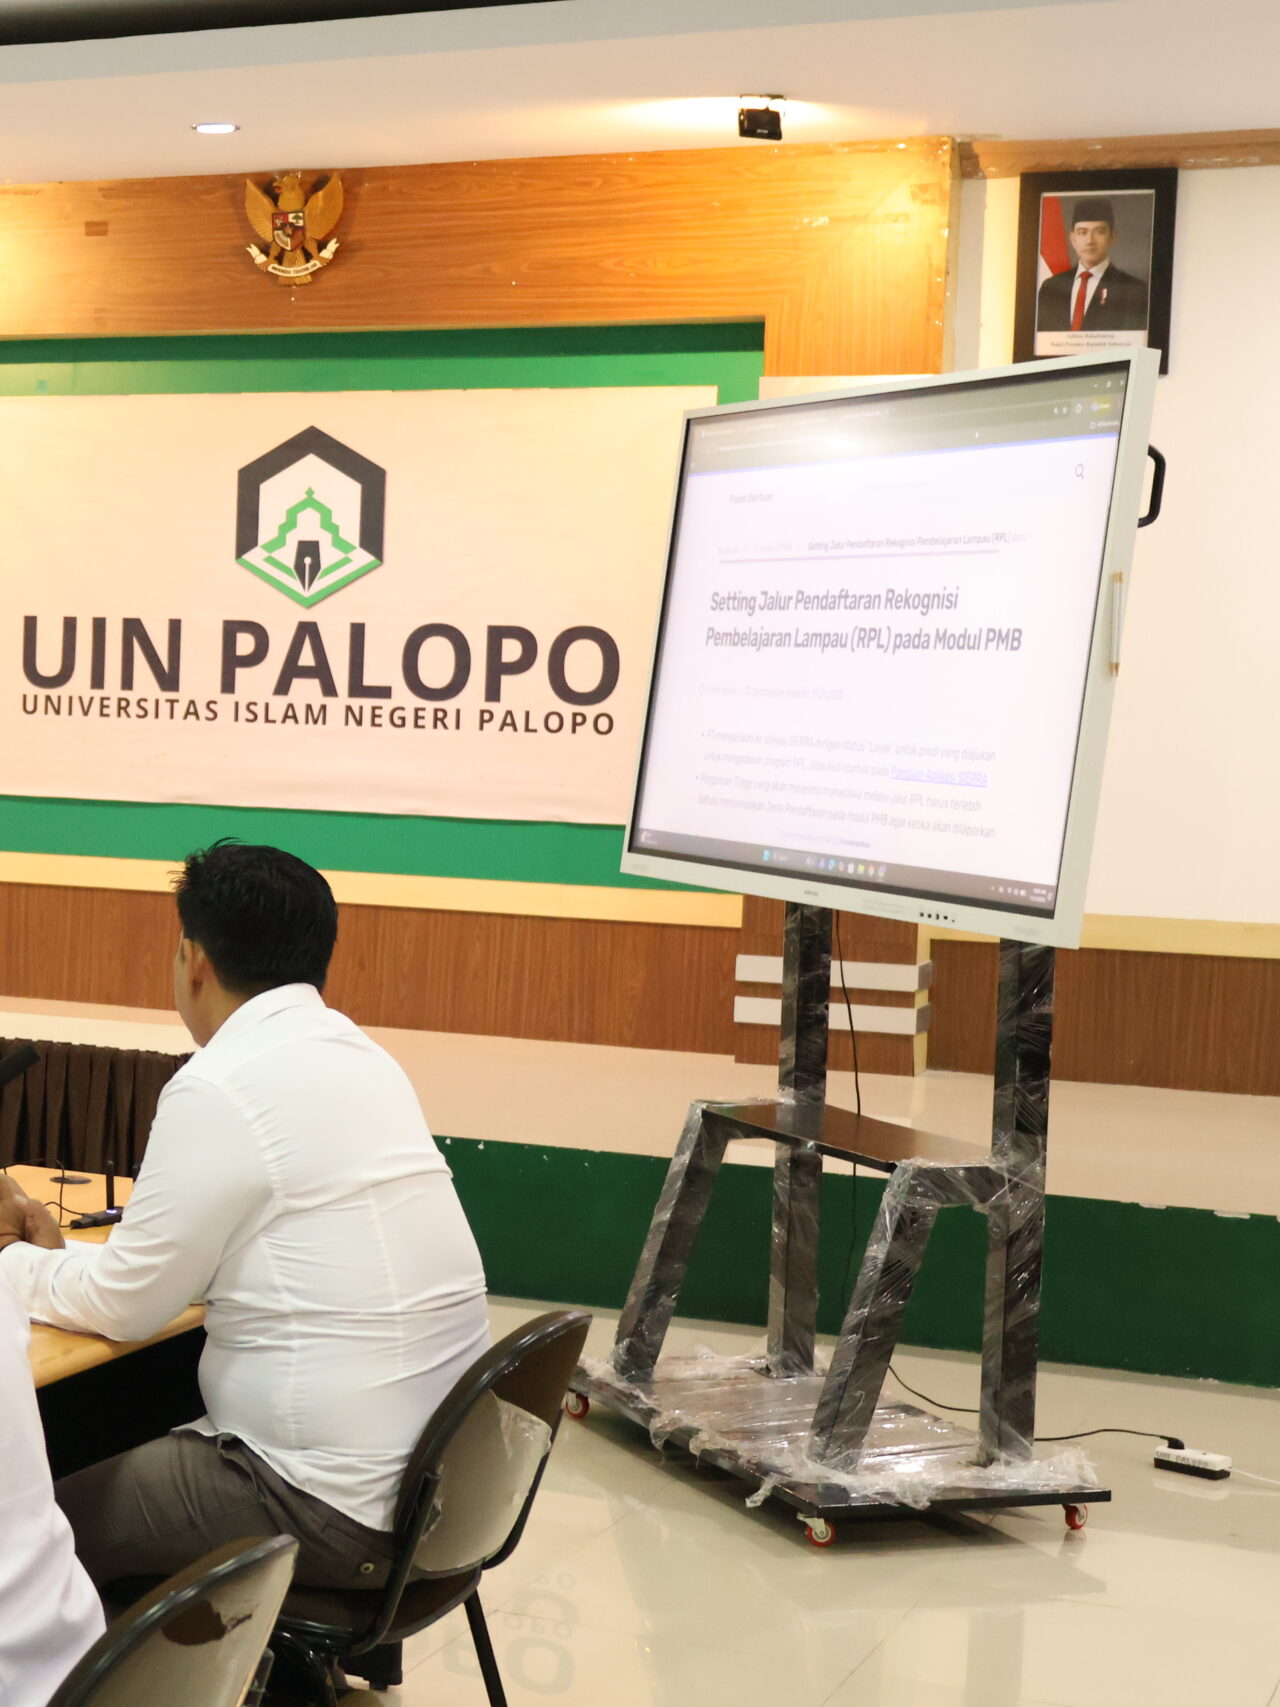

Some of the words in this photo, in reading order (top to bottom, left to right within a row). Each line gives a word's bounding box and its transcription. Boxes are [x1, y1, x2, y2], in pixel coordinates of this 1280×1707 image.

[710, 591, 757, 616] Setting
[758, 590, 793, 611] Jalur
[794, 588, 882, 611] Pendaftaran
[884, 586, 959, 616] Rekognisi
[705, 626, 792, 652] Pembelajaran
[793, 627, 849, 653] Lampau
[850, 625, 891, 653] (RPL)
[892, 627, 931, 655] pada
[933, 627, 983, 651] Modul
[984, 628, 1023, 651] PMB
[22, 615, 182, 693] UIN
[220, 619, 620, 707] PALOPO
[22, 694, 218, 721] UNIVERSITAS
[233, 701, 327, 725] ISLAM
[344, 705, 461, 730] NEGERI
[478, 709, 614, 735] PALOPO
